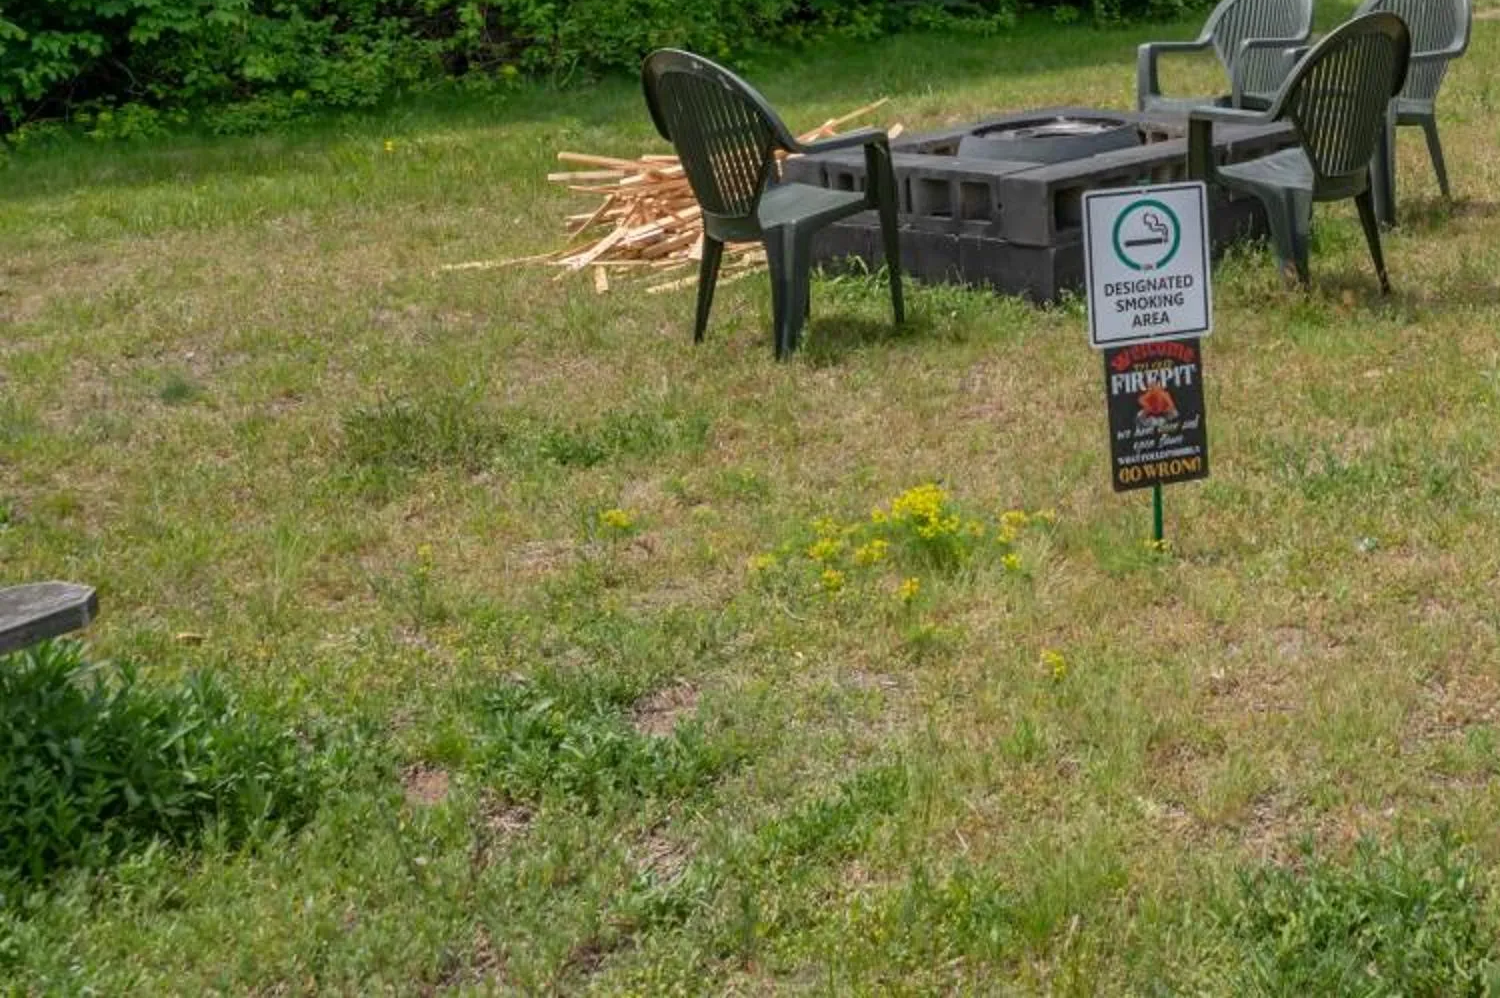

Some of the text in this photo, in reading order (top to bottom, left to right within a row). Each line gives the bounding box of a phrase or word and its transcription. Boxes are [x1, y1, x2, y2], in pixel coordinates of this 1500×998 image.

[1104, 274, 1193, 297] DESIGNATED
[1115, 292, 1184, 313] SMOKING
[1132, 311, 1170, 328] AREA
[1111, 363, 1197, 395] FIREPIT
[1119, 465, 1142, 483] GO
